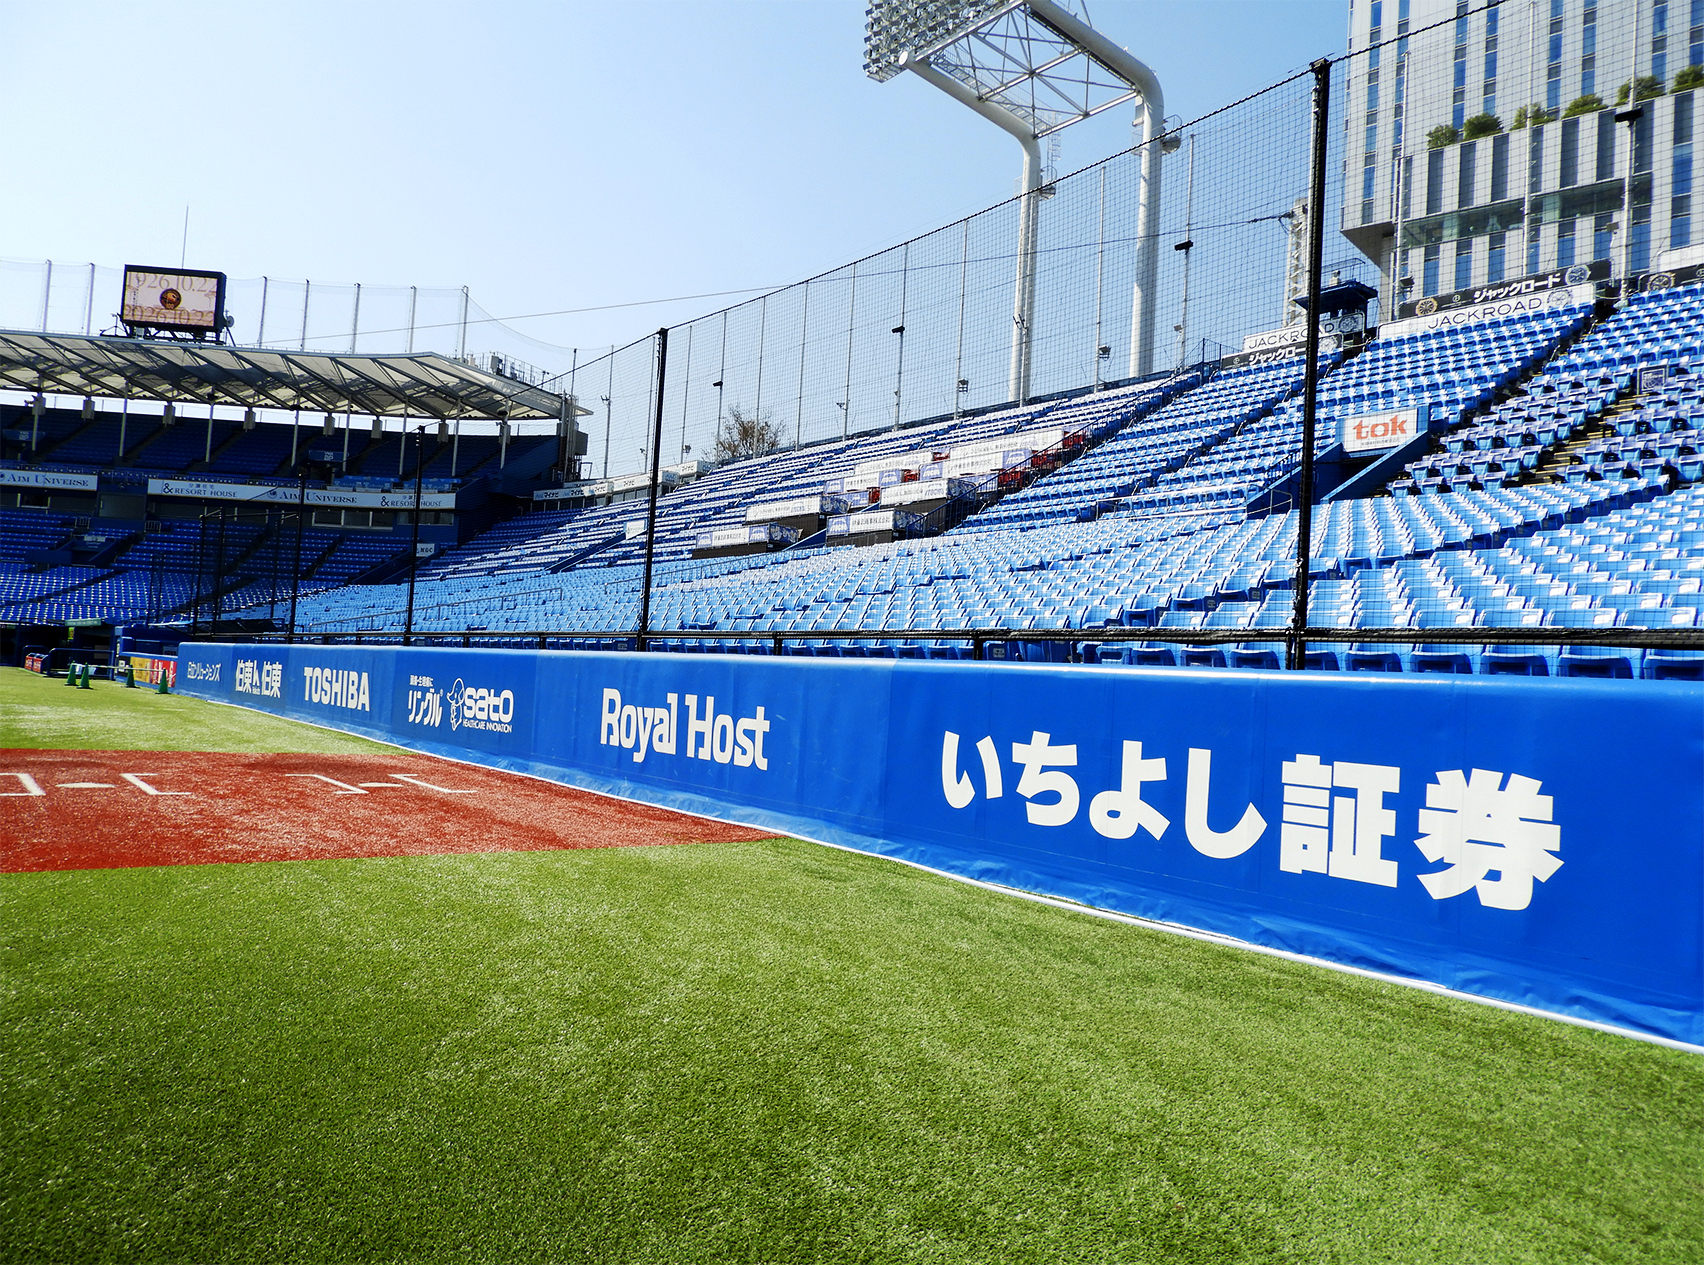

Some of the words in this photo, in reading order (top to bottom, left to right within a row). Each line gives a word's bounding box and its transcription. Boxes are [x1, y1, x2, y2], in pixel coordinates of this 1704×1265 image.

[1473, 273, 1562, 304] ジャックロード
[1427, 298, 1543, 329] JACKROAD
[1249, 322, 1335, 349] JACKROD
[1248, 346, 1307, 365] ジャックロー
[1353, 415, 1408, 440] tok
[174, 487, 207, 496] RESORT
[210, 490, 238, 498] HOUSE
[390, 500, 415, 508] RESOR
[304, 666, 370, 712] TOSHIBA
[408, 688, 443, 728] リングル
[463, 687, 514, 723] sato
[600, 687, 679, 763] Royal
[685, 693, 771, 771] Host
[941, 730, 1565, 911] いちよし証券
